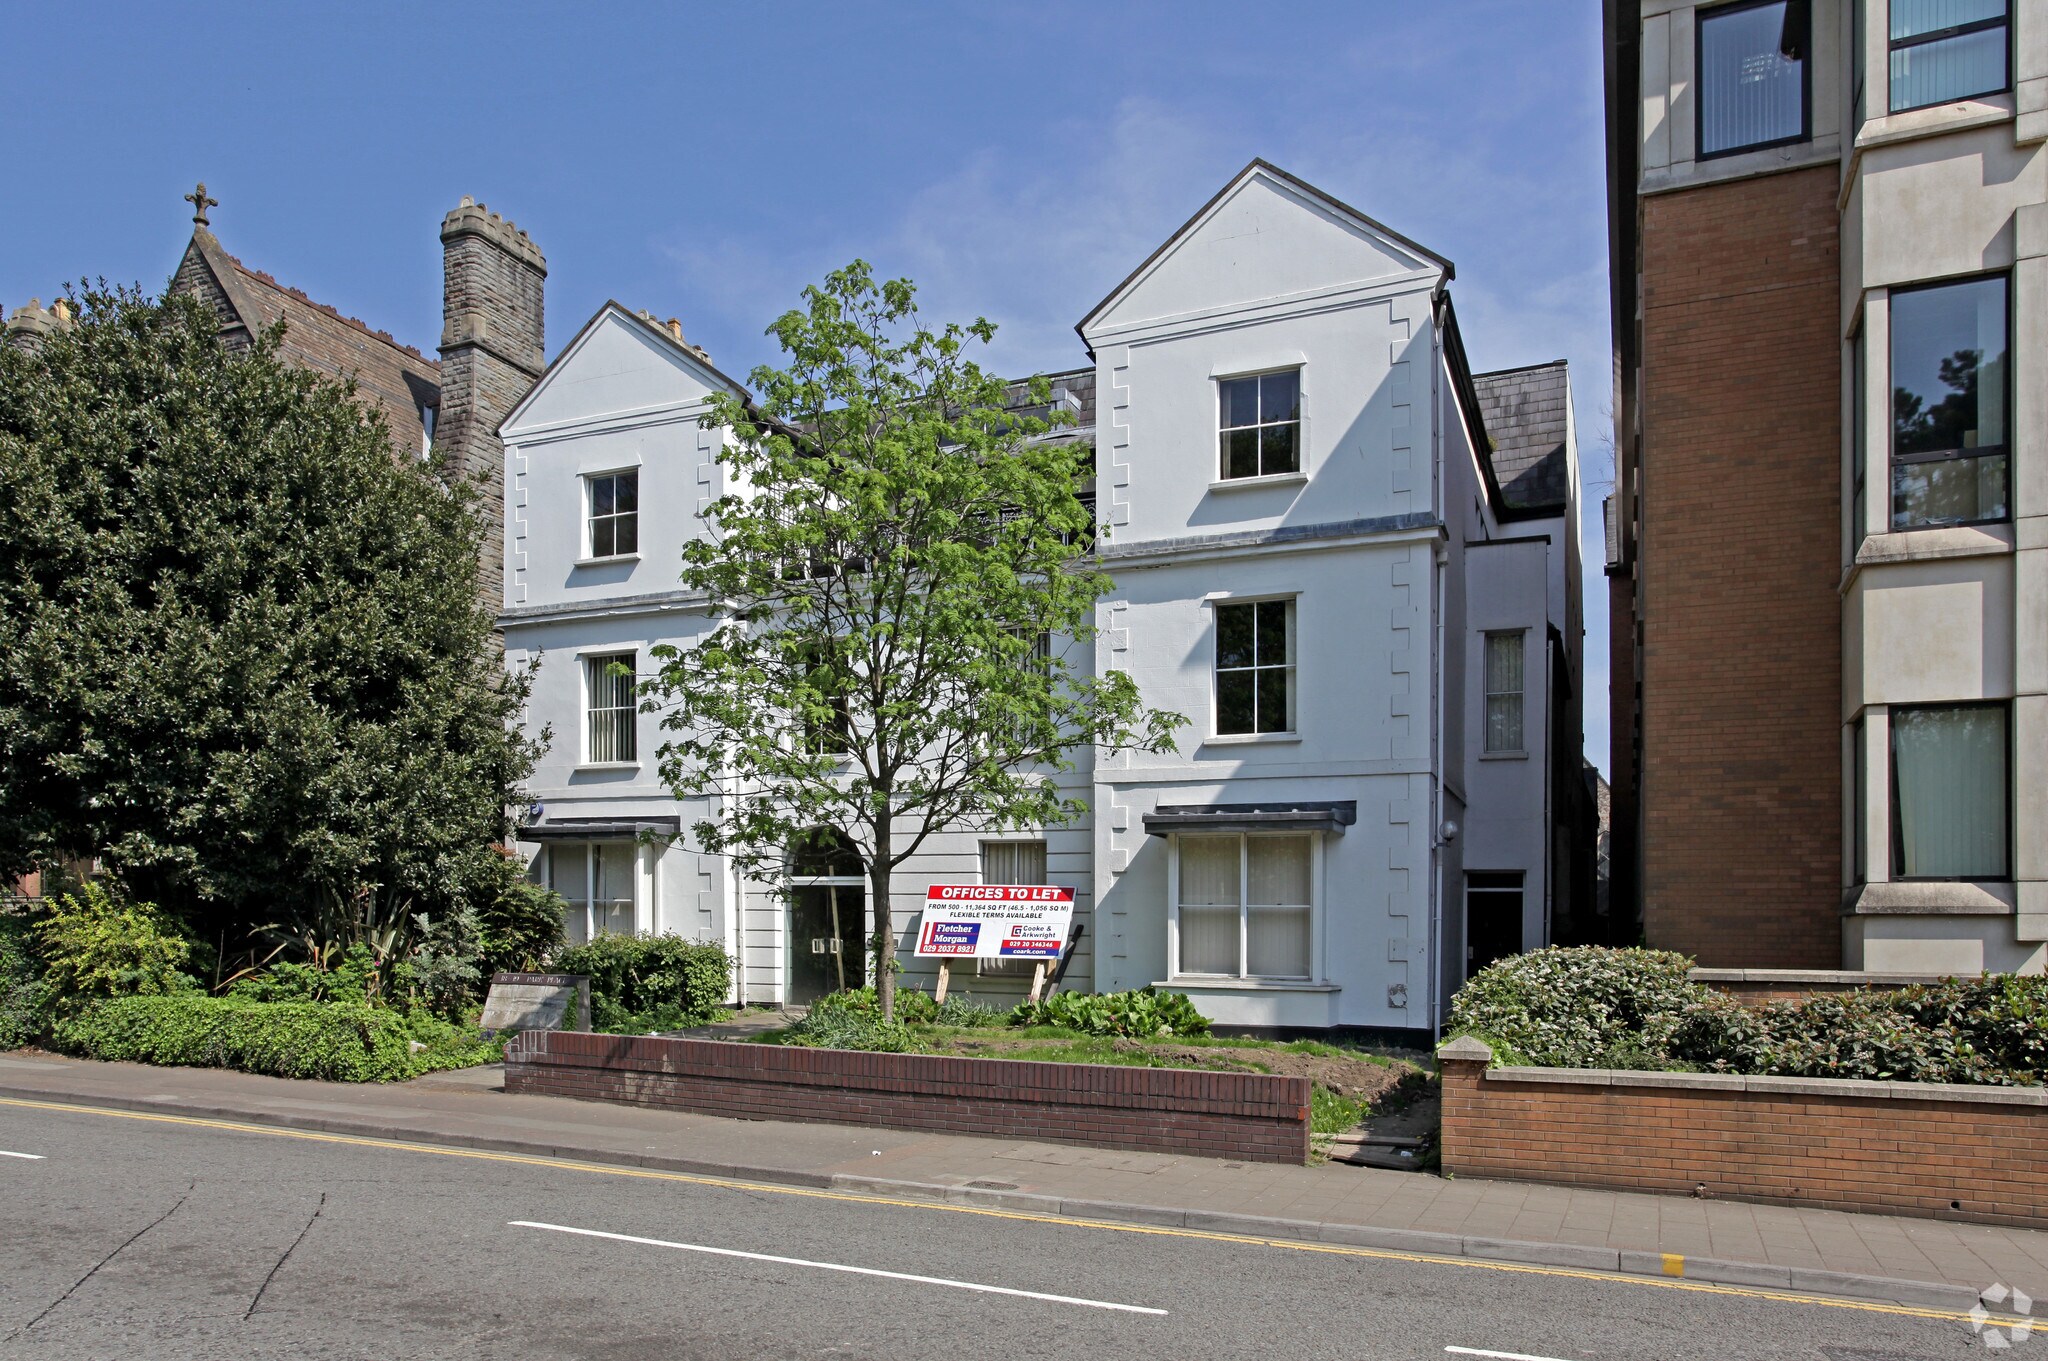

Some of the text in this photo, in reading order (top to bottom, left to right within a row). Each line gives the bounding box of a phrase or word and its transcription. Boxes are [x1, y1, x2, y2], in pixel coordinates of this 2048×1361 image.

[941, 887, 1062, 900] OFFICES TO LET
[936, 924, 973, 933] Fletcher
[934, 935, 968, 944] Morgan
[923, 944, 975, 953] 029 2037 8921
